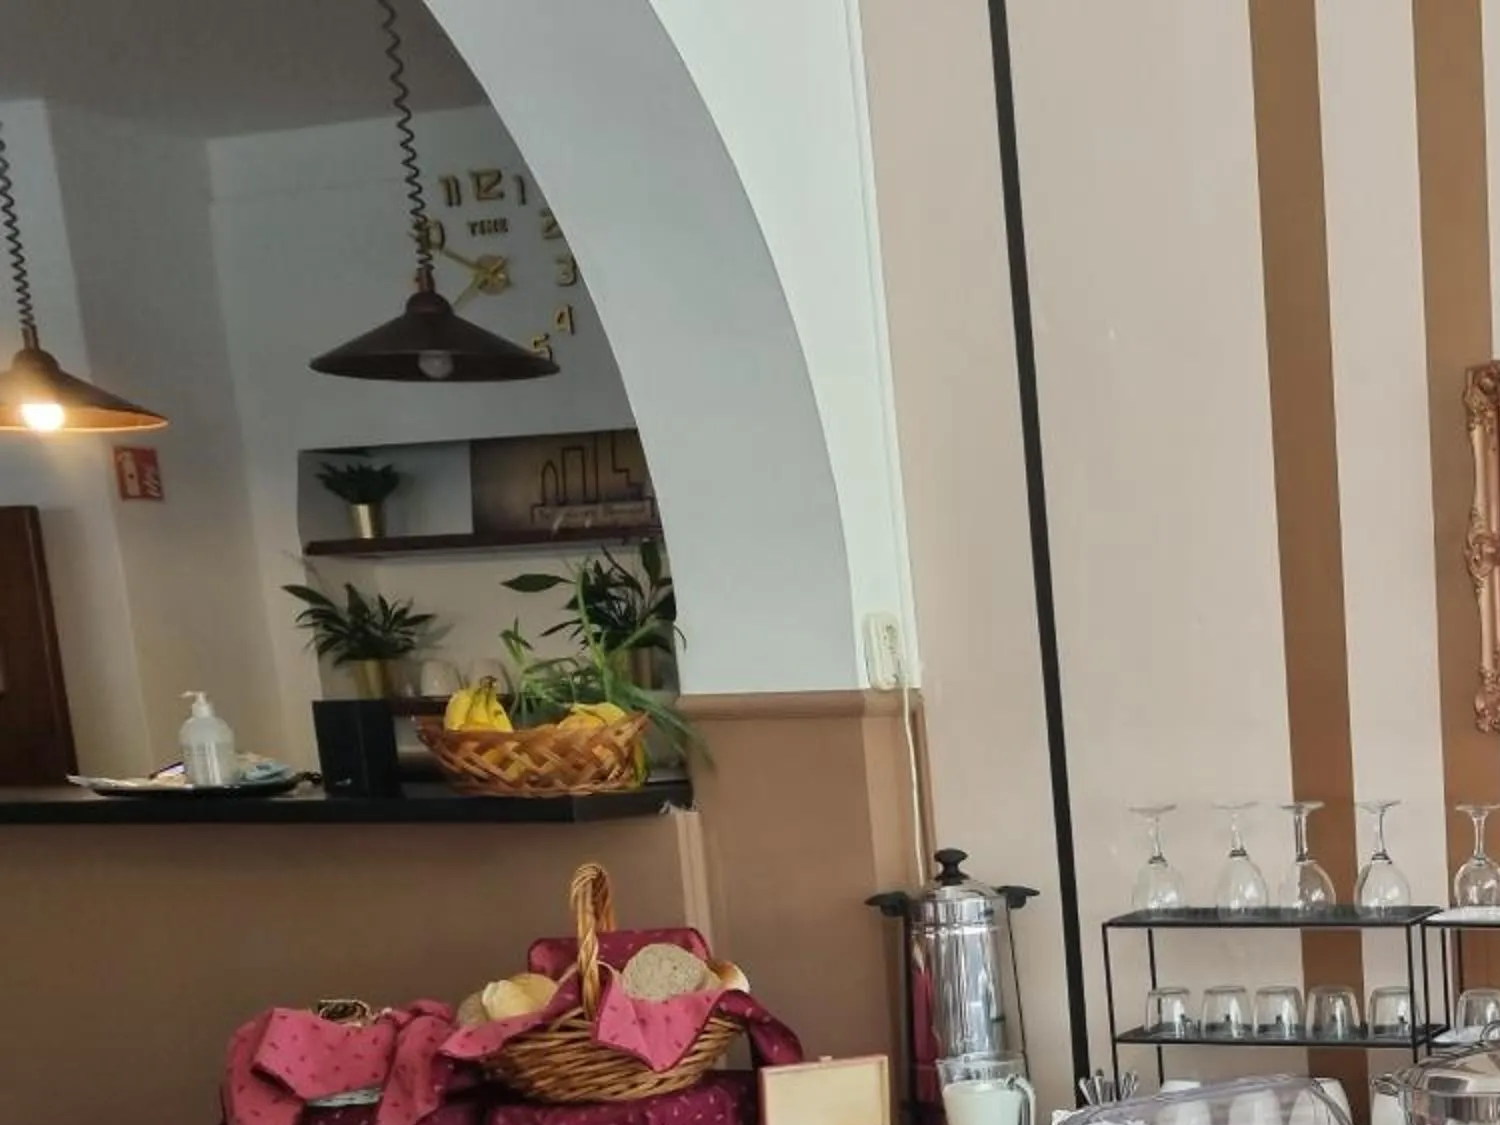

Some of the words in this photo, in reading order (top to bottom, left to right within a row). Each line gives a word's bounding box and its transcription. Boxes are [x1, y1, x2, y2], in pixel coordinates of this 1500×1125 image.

[439, 175, 461, 207] 11
[468, 168, 505, 201] 12
[513, 173, 527, 206] 1
[556, 255, 577, 287] 3
